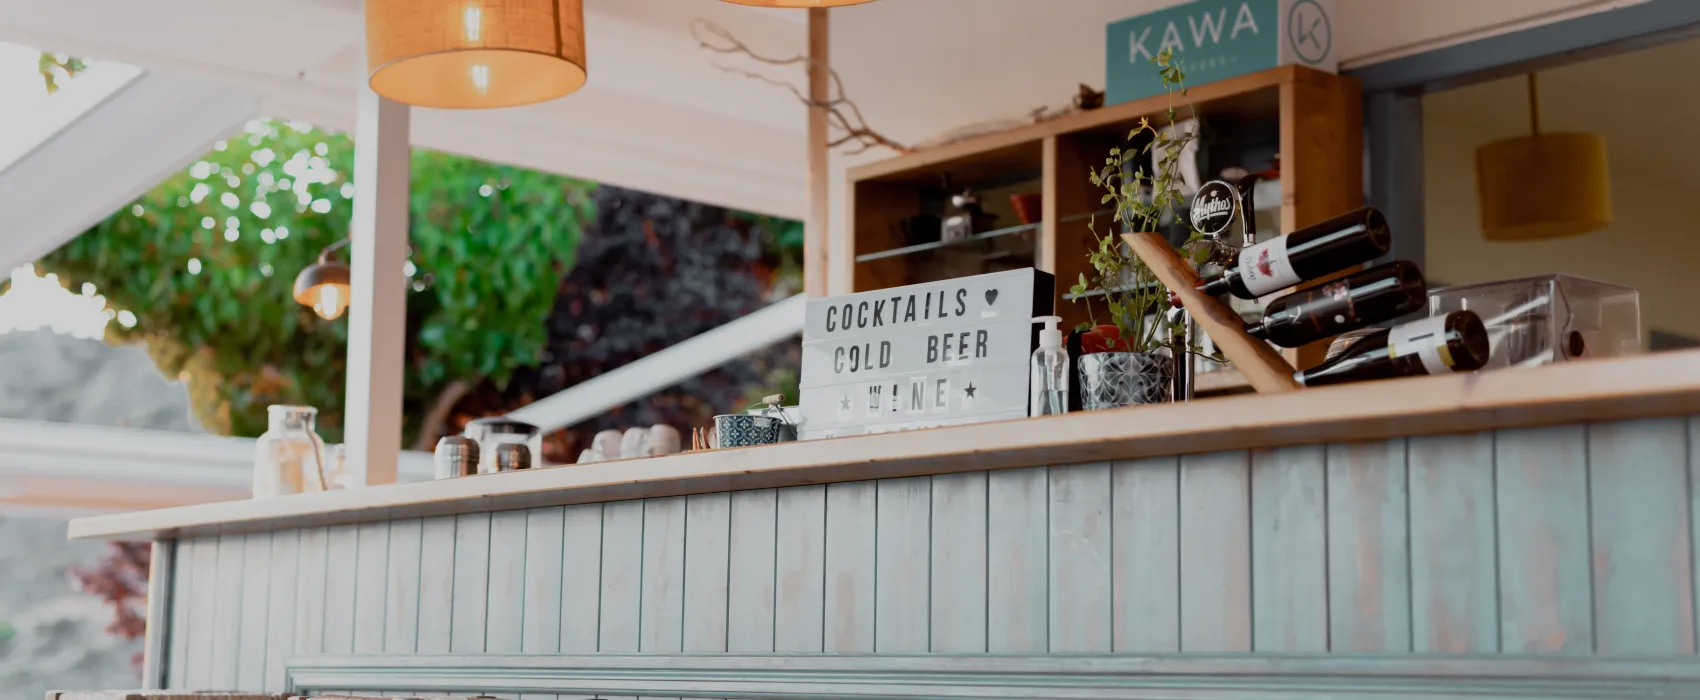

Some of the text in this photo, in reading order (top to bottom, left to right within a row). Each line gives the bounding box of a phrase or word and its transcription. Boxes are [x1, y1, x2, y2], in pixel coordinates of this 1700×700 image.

[1129, 2, 1259, 65] KAWA
[1192, 195, 1230, 222] Mythos
[826, 288, 967, 333] COCKTAILS
[833, 329, 988, 374] COLD BEER
[869, 378, 947, 412] WINE
